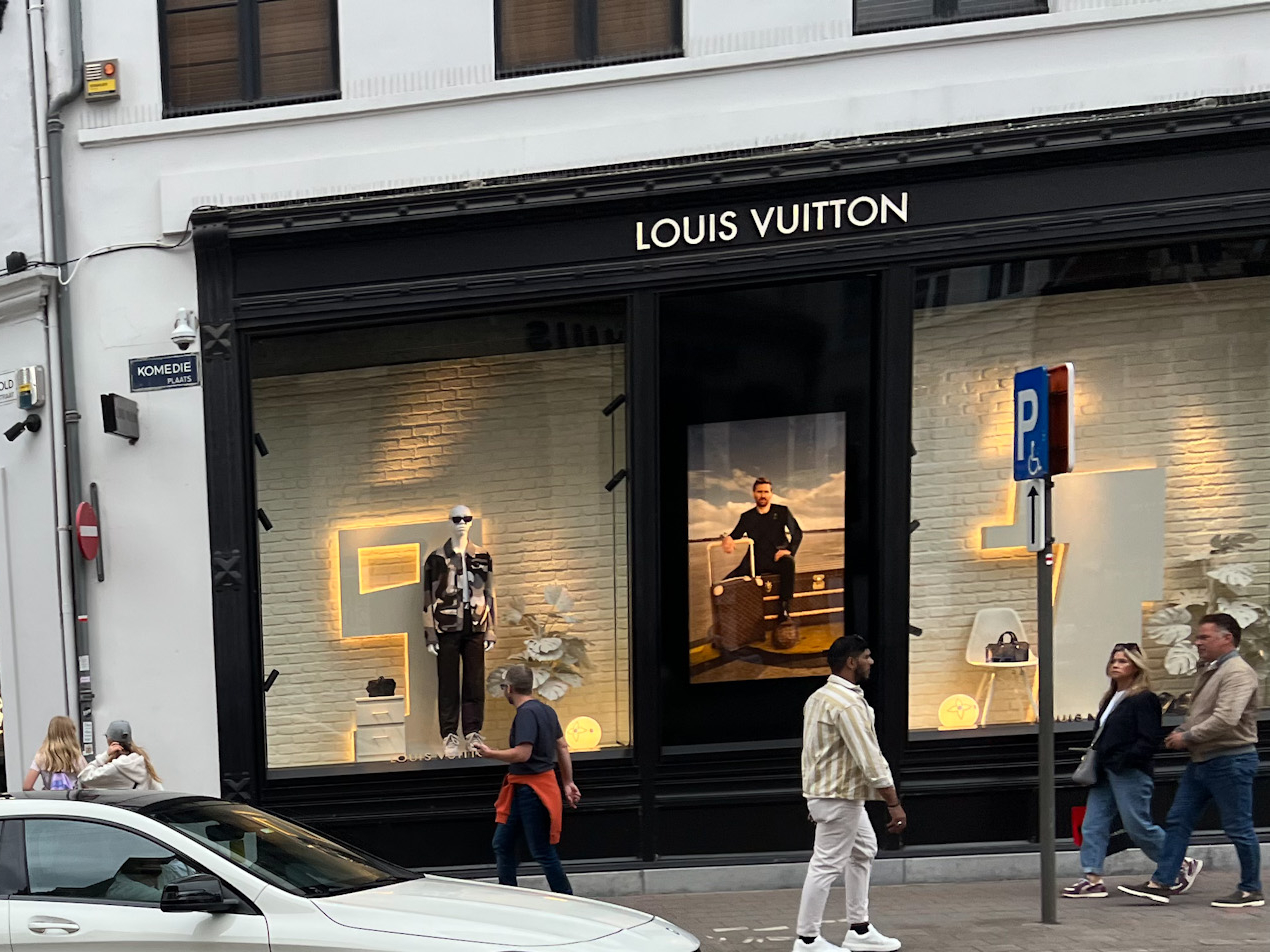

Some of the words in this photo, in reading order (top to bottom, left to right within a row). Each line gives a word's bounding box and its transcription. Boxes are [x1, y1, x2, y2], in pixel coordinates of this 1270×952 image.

[636, 210, 738, 251] LOUIS
[750, 191, 908, 238] VUITTON
[137, 361, 192, 377] KOMEDIE
[167, 375, 193, 385] PLAATS
